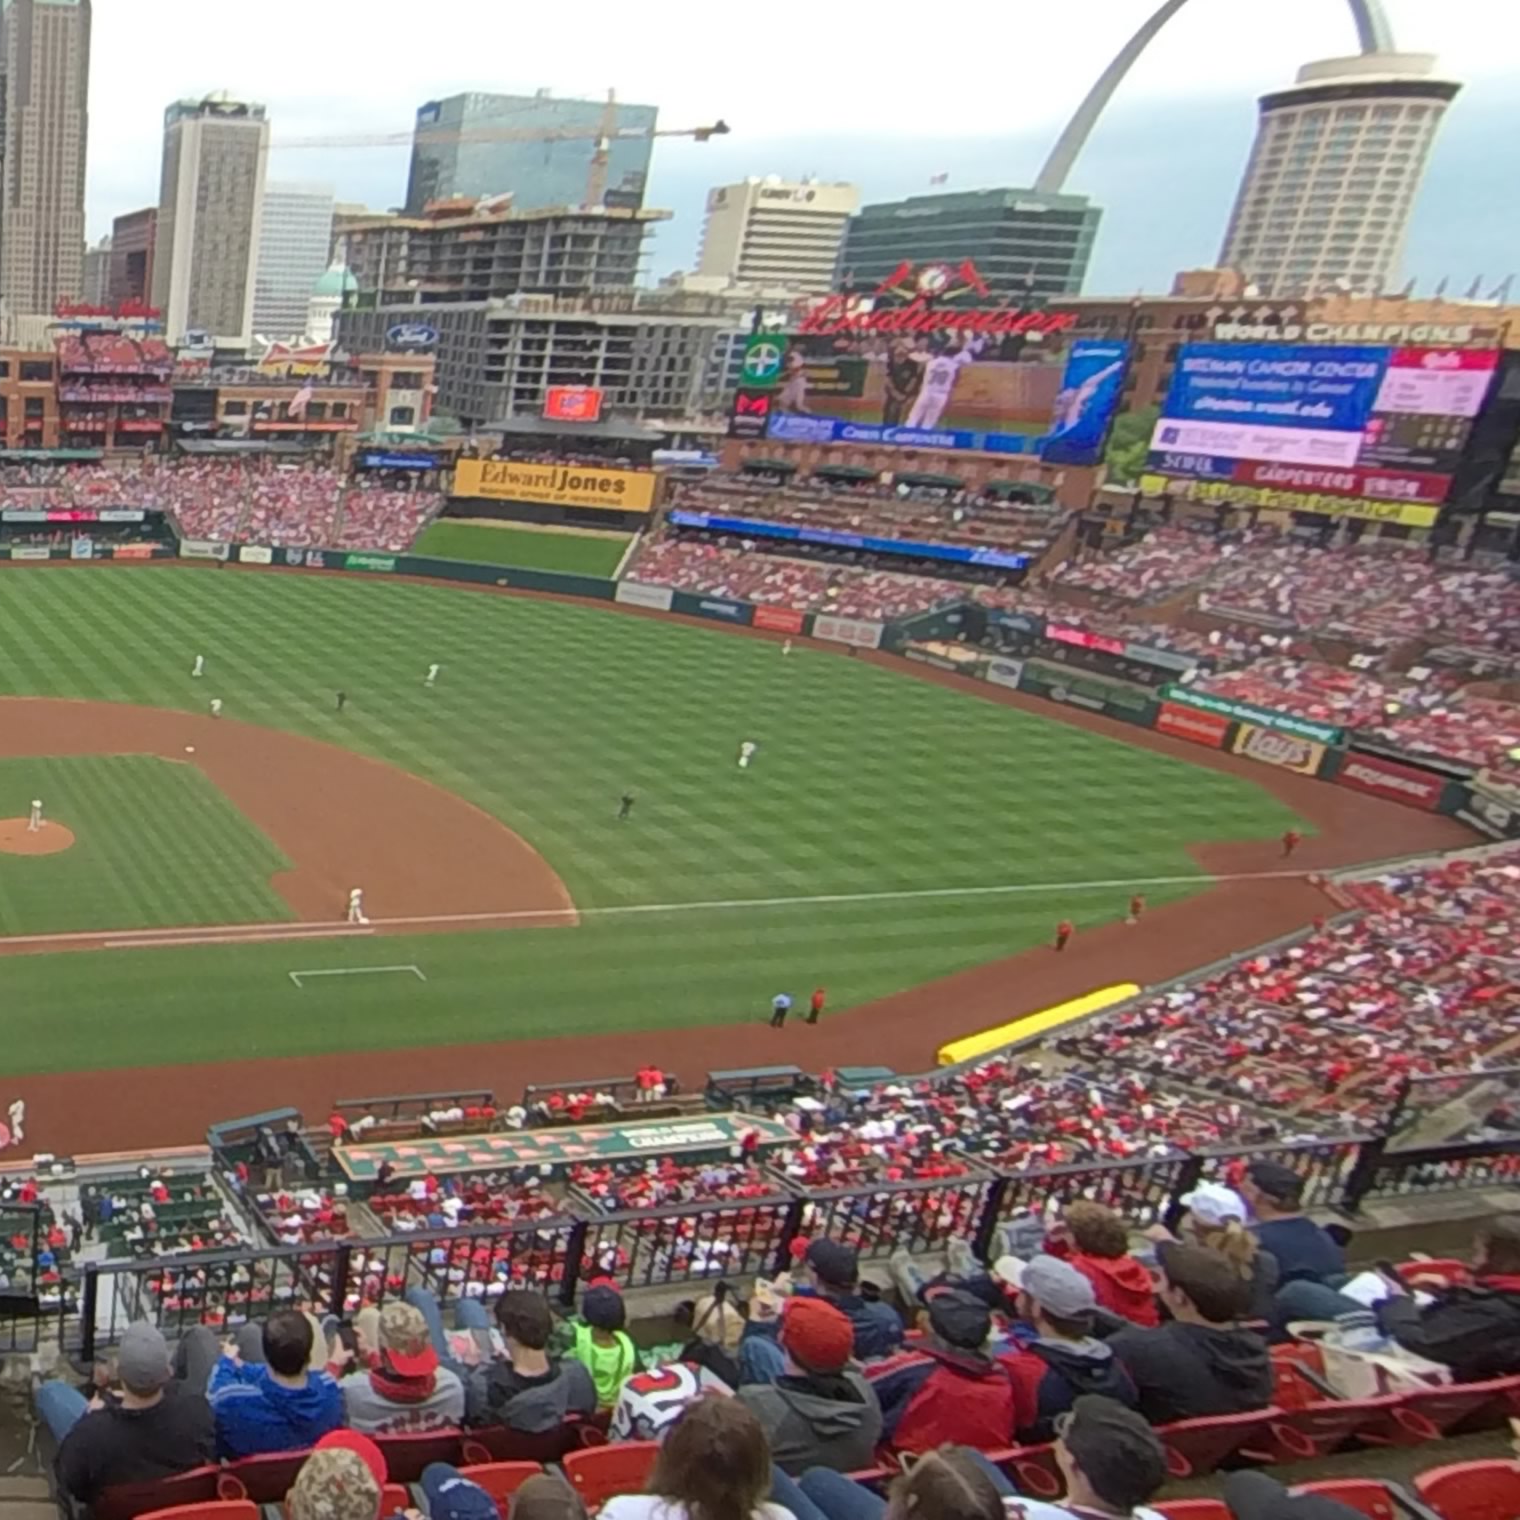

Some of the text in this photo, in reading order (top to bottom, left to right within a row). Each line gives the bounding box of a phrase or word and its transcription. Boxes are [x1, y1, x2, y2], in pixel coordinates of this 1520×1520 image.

[797, 293, 1079, 334] Budweiser
[1215, 322, 1473, 343] WORLD CHAMPIONS
[1311, 361, 1379, 378] CENTER
[480, 463, 626, 494] Edward Jones
[1254, 463, 1358, 490] CARPENTERS
